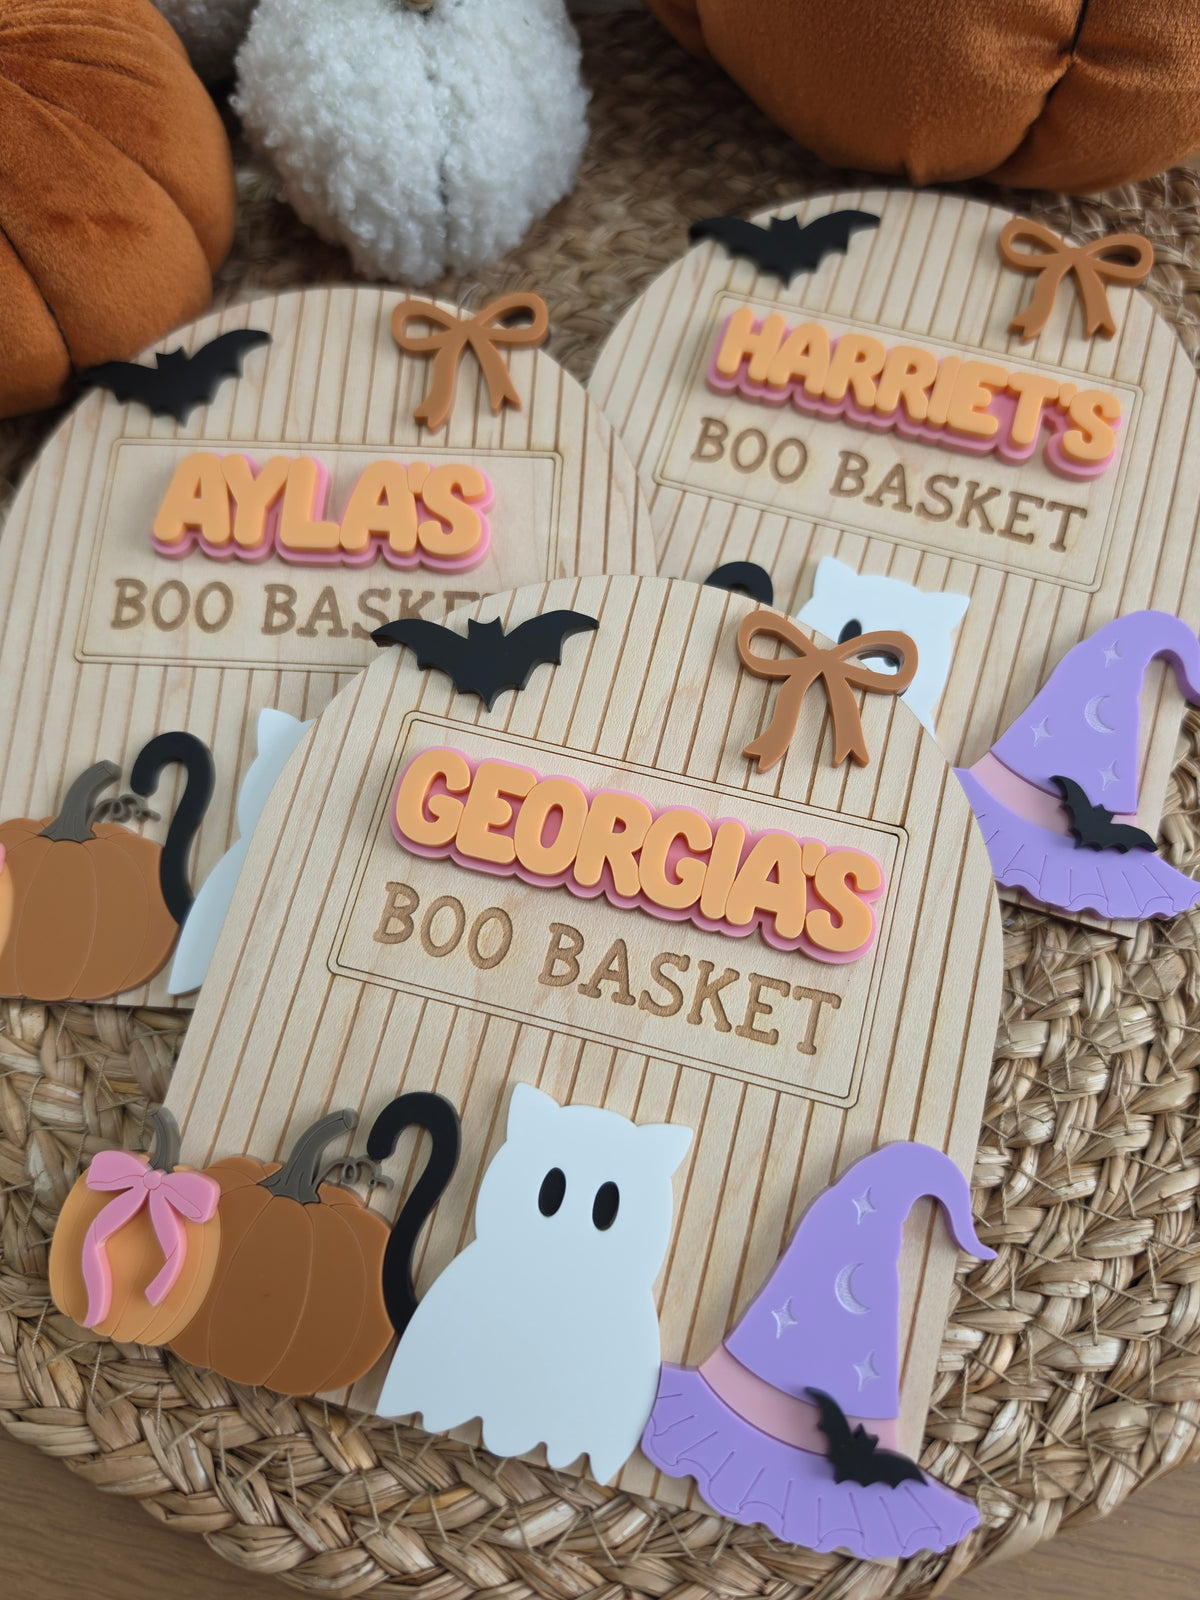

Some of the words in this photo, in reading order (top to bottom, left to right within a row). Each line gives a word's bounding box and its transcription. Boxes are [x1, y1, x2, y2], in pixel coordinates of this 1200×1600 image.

[709, 307, 1121, 480] HARRIET'S
[151, 452, 494, 573] AYLA'S
[690, 417, 808, 484] BOO
[829, 450, 1088, 552] BASKET
[110, 578, 234, 633] BOO
[261, 583, 497, 640] BASK
[391, 746, 886, 964] GEORGIA'S
[372, 881, 514, 970] BOO
[537, 922, 843, 1056] BASKET
